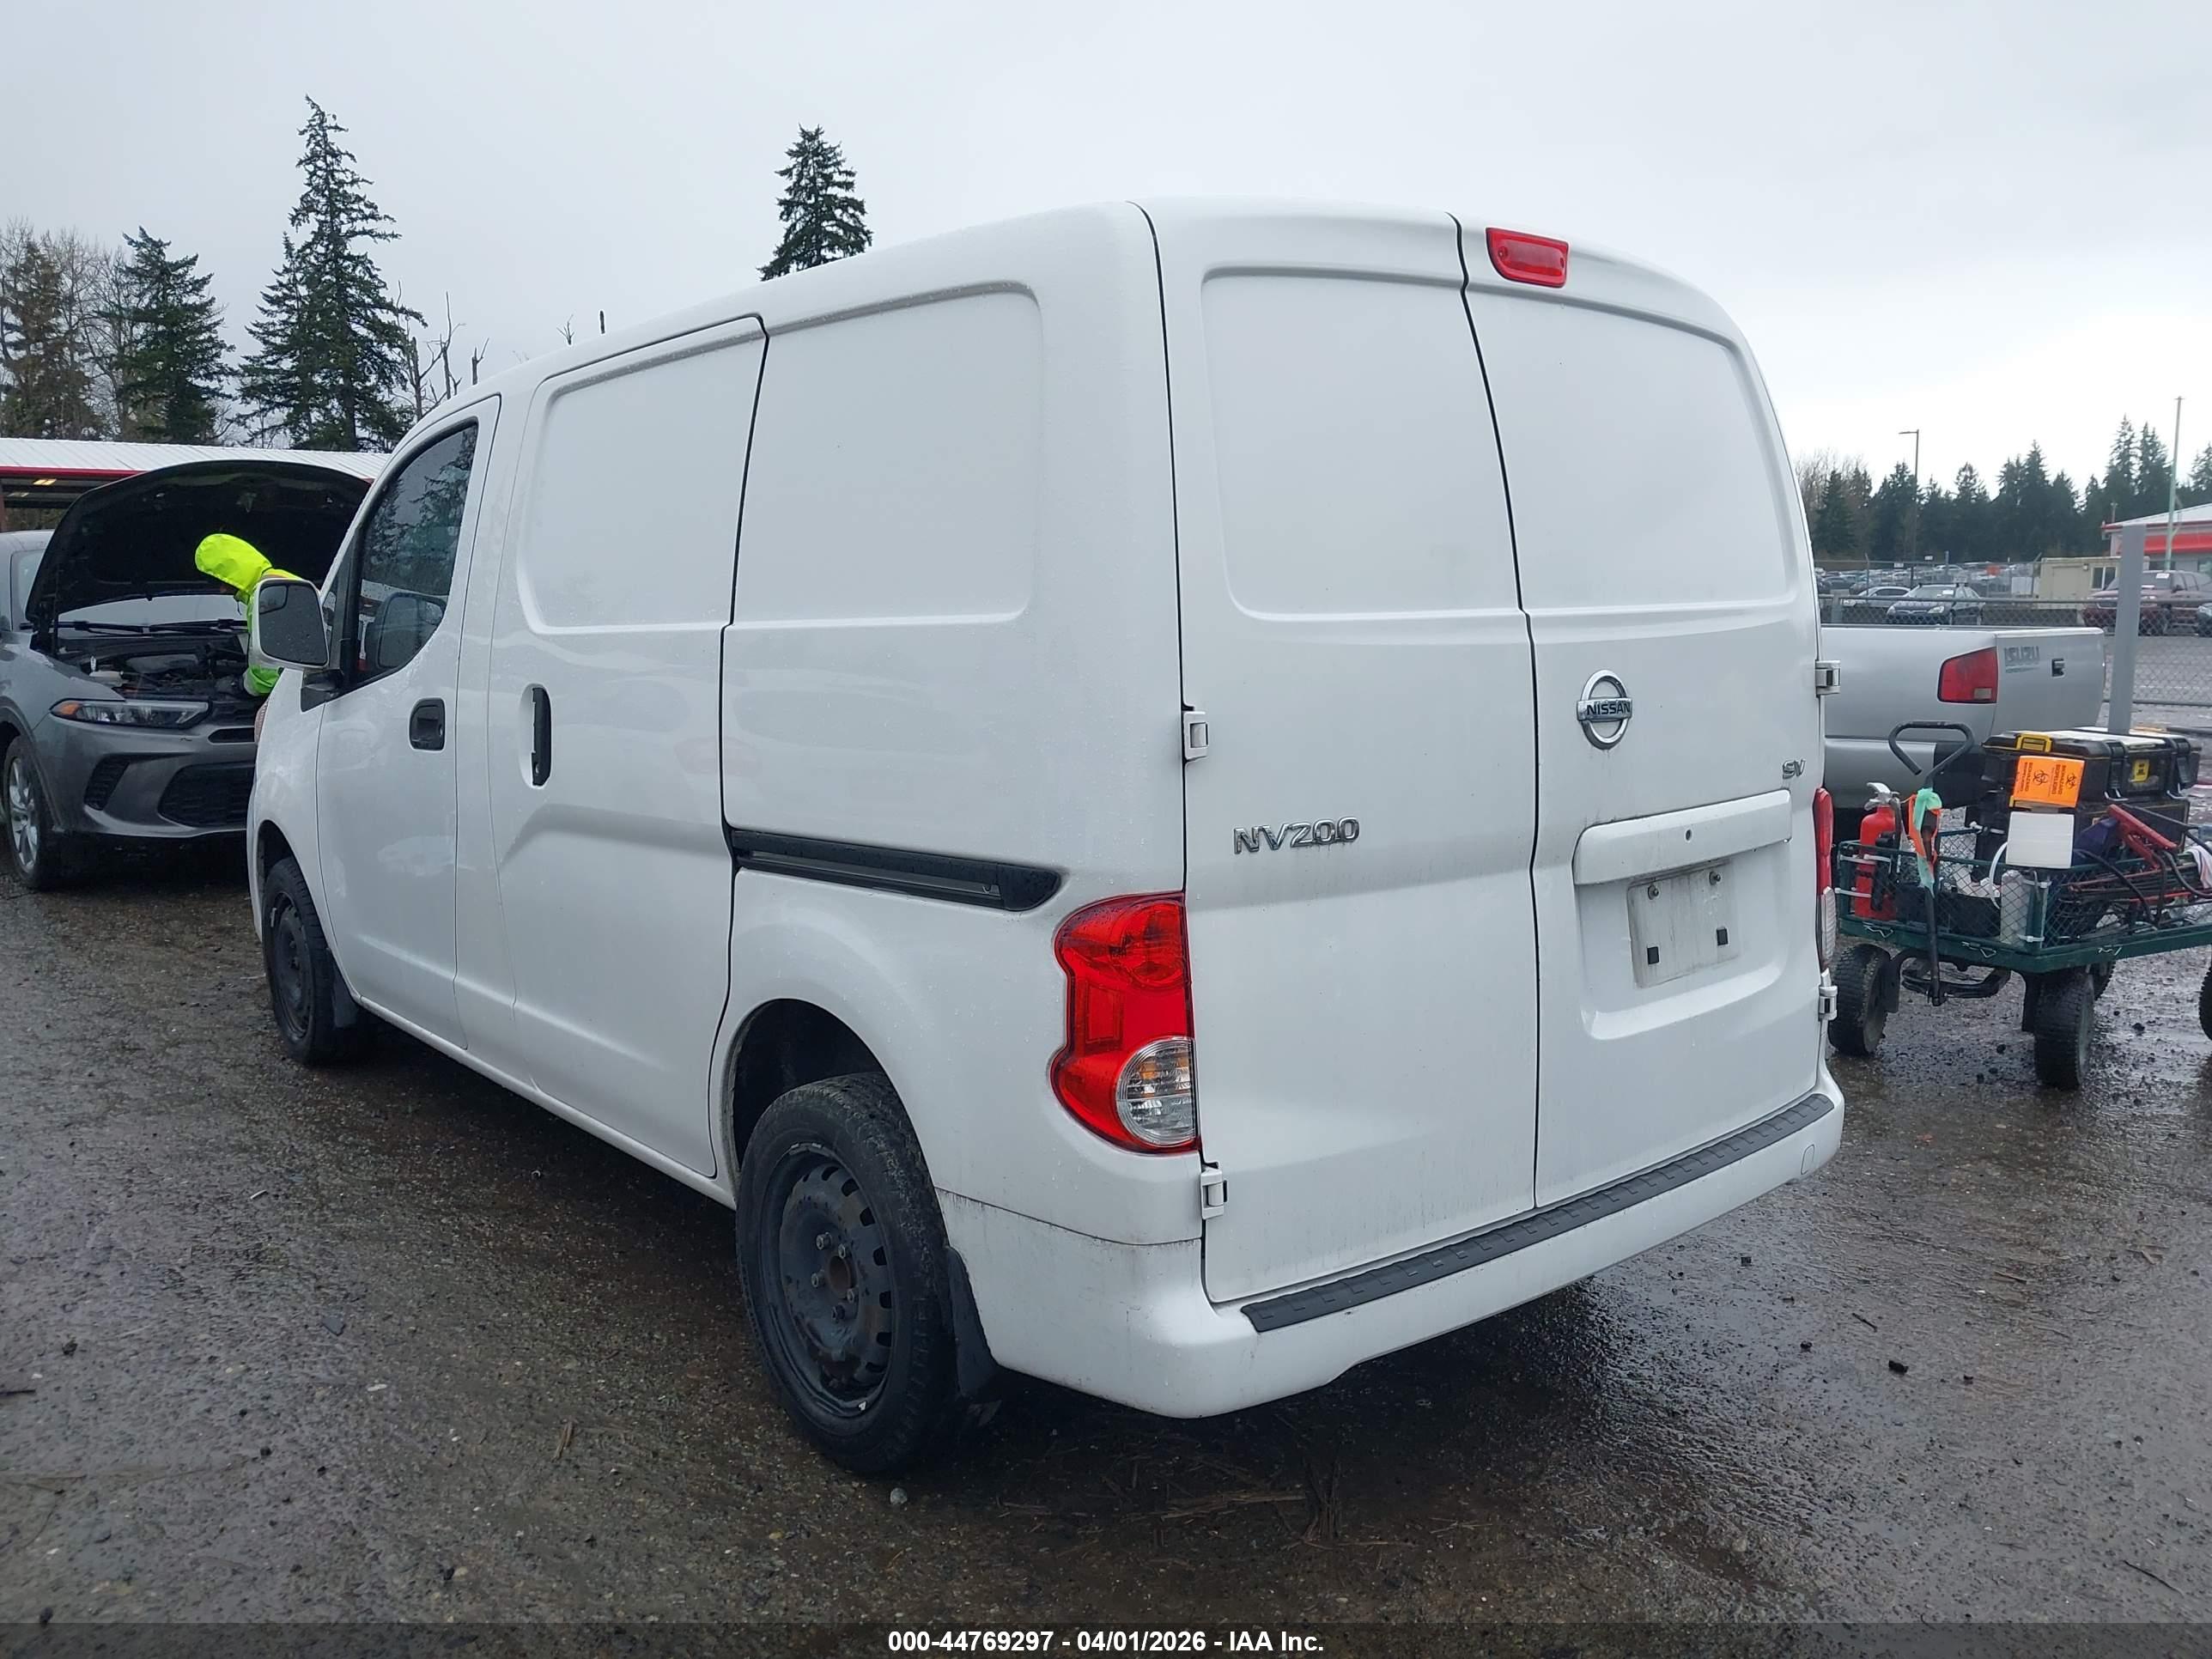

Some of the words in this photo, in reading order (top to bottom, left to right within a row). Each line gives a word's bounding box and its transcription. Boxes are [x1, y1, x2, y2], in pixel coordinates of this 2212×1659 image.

[1586, 702, 1631, 715] NISSAN
[1783, 759, 1806, 779] SV
[1233, 817, 1360, 854] NV200
